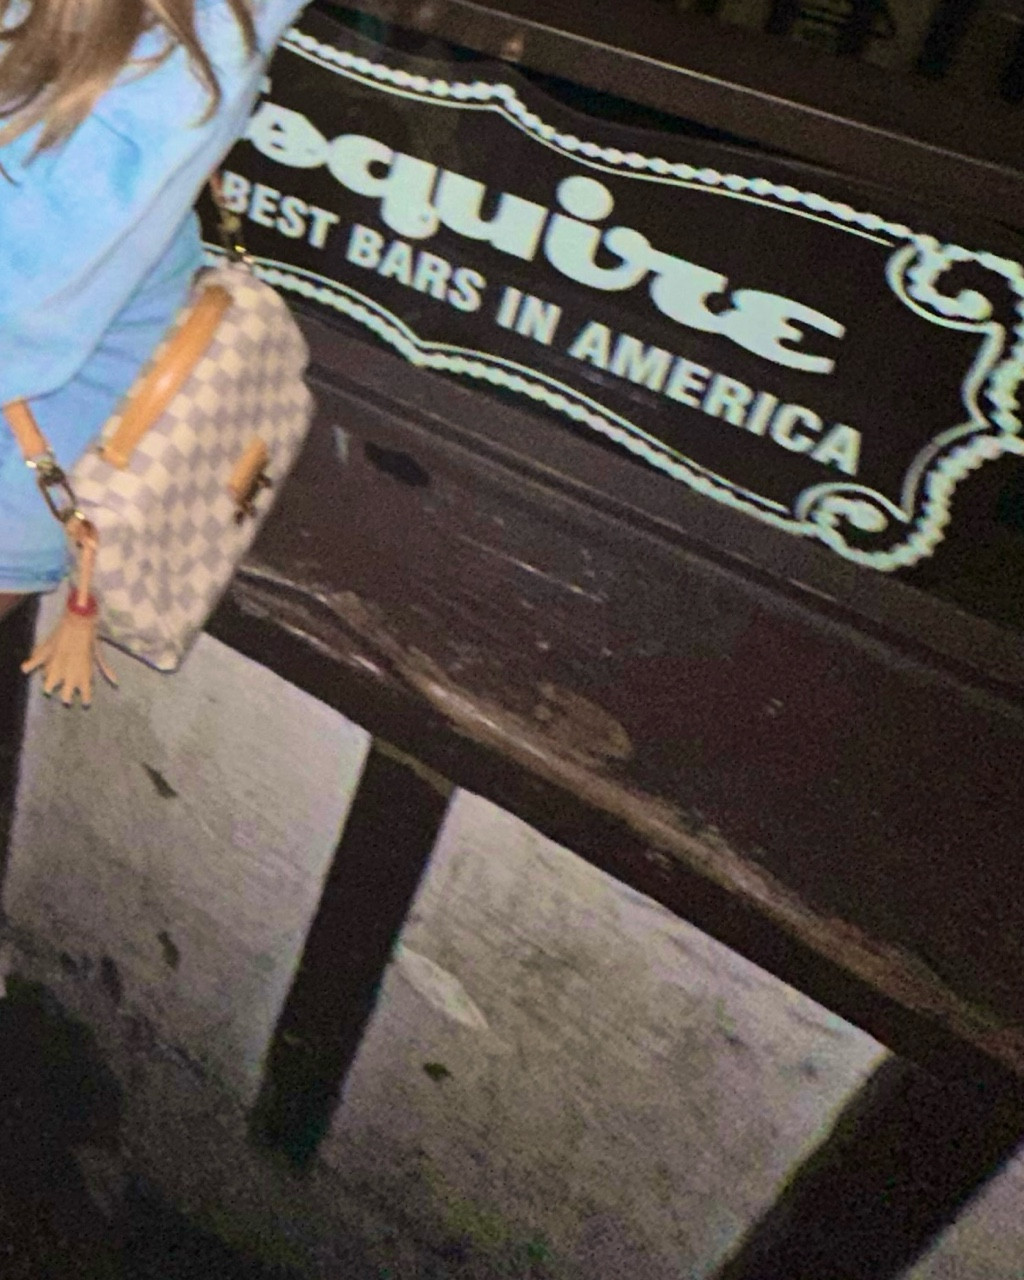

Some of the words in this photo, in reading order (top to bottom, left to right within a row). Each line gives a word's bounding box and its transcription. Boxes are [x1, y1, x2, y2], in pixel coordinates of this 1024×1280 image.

[220, 170, 339, 248] BEST
[347, 223, 486, 312] BARS
[496, 286, 562, 345] IN
[568, 321, 861, 475] AMERICA
